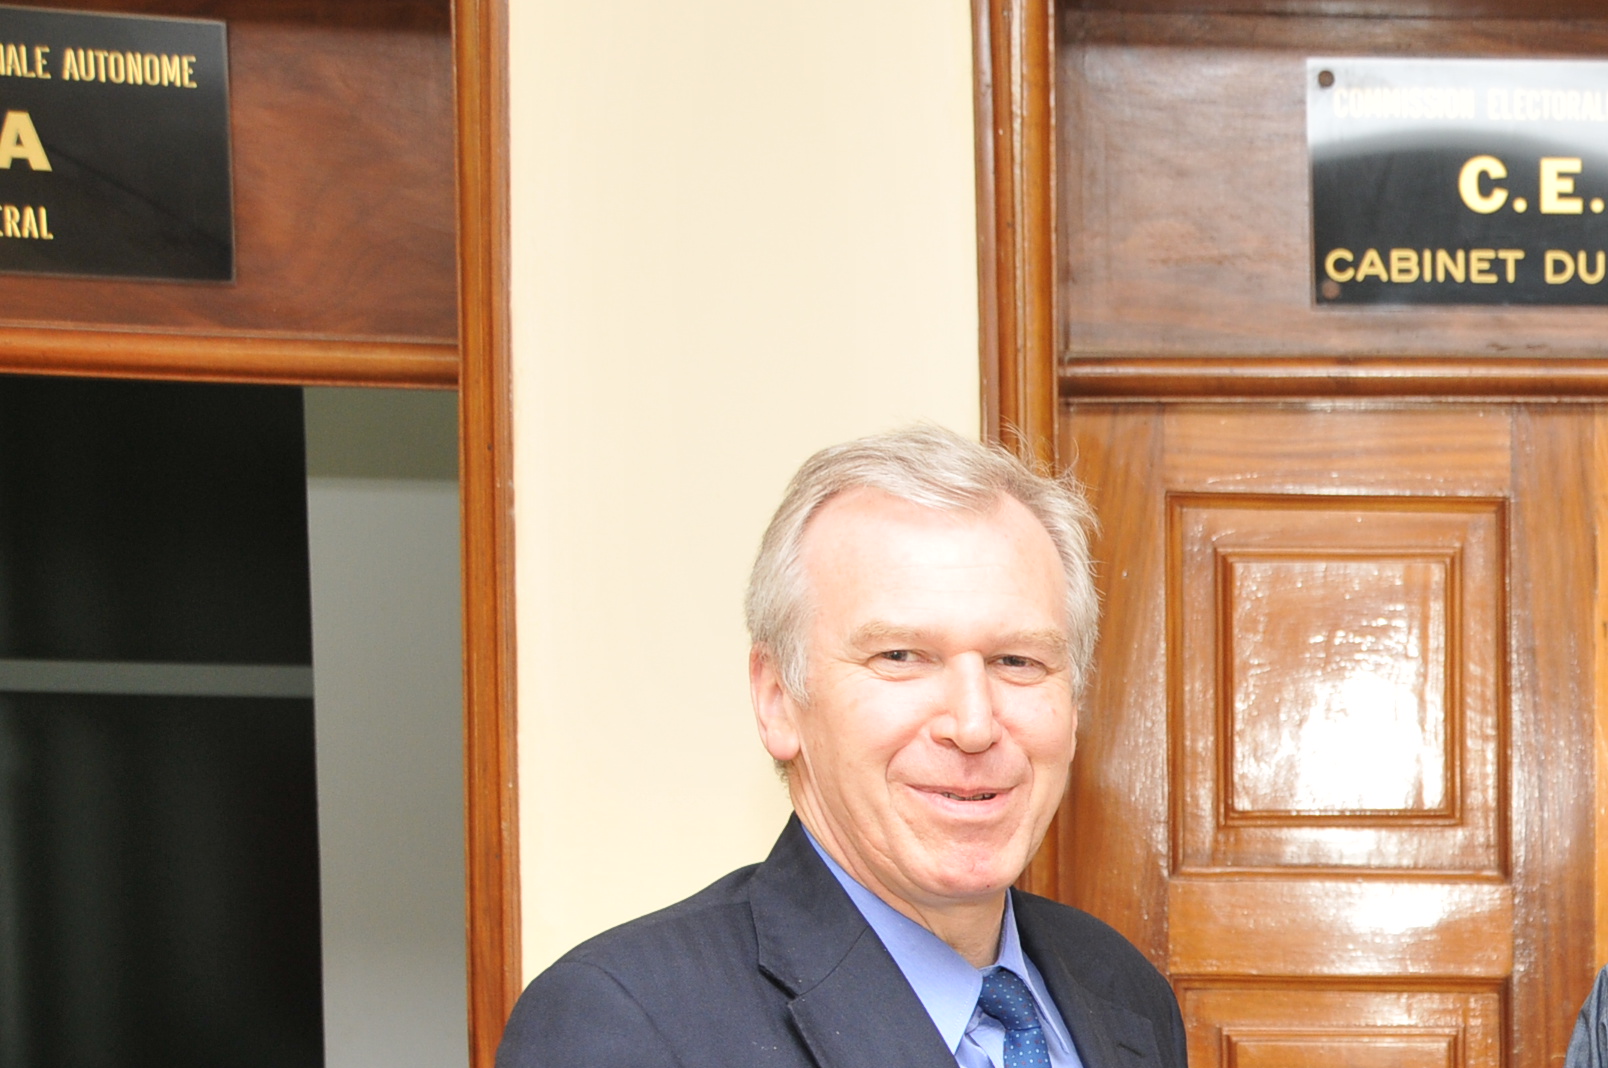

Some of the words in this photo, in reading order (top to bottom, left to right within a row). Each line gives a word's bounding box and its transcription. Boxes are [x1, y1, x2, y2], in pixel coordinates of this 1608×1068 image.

[62, 48, 197, 88] AUTONOME
[1334, 88, 1475, 119] COMMISSION
[0, 204, 54, 240] RAL
[1324, 248, 1525, 284] CABINET
[1544, 250, 1606, 285] DU
